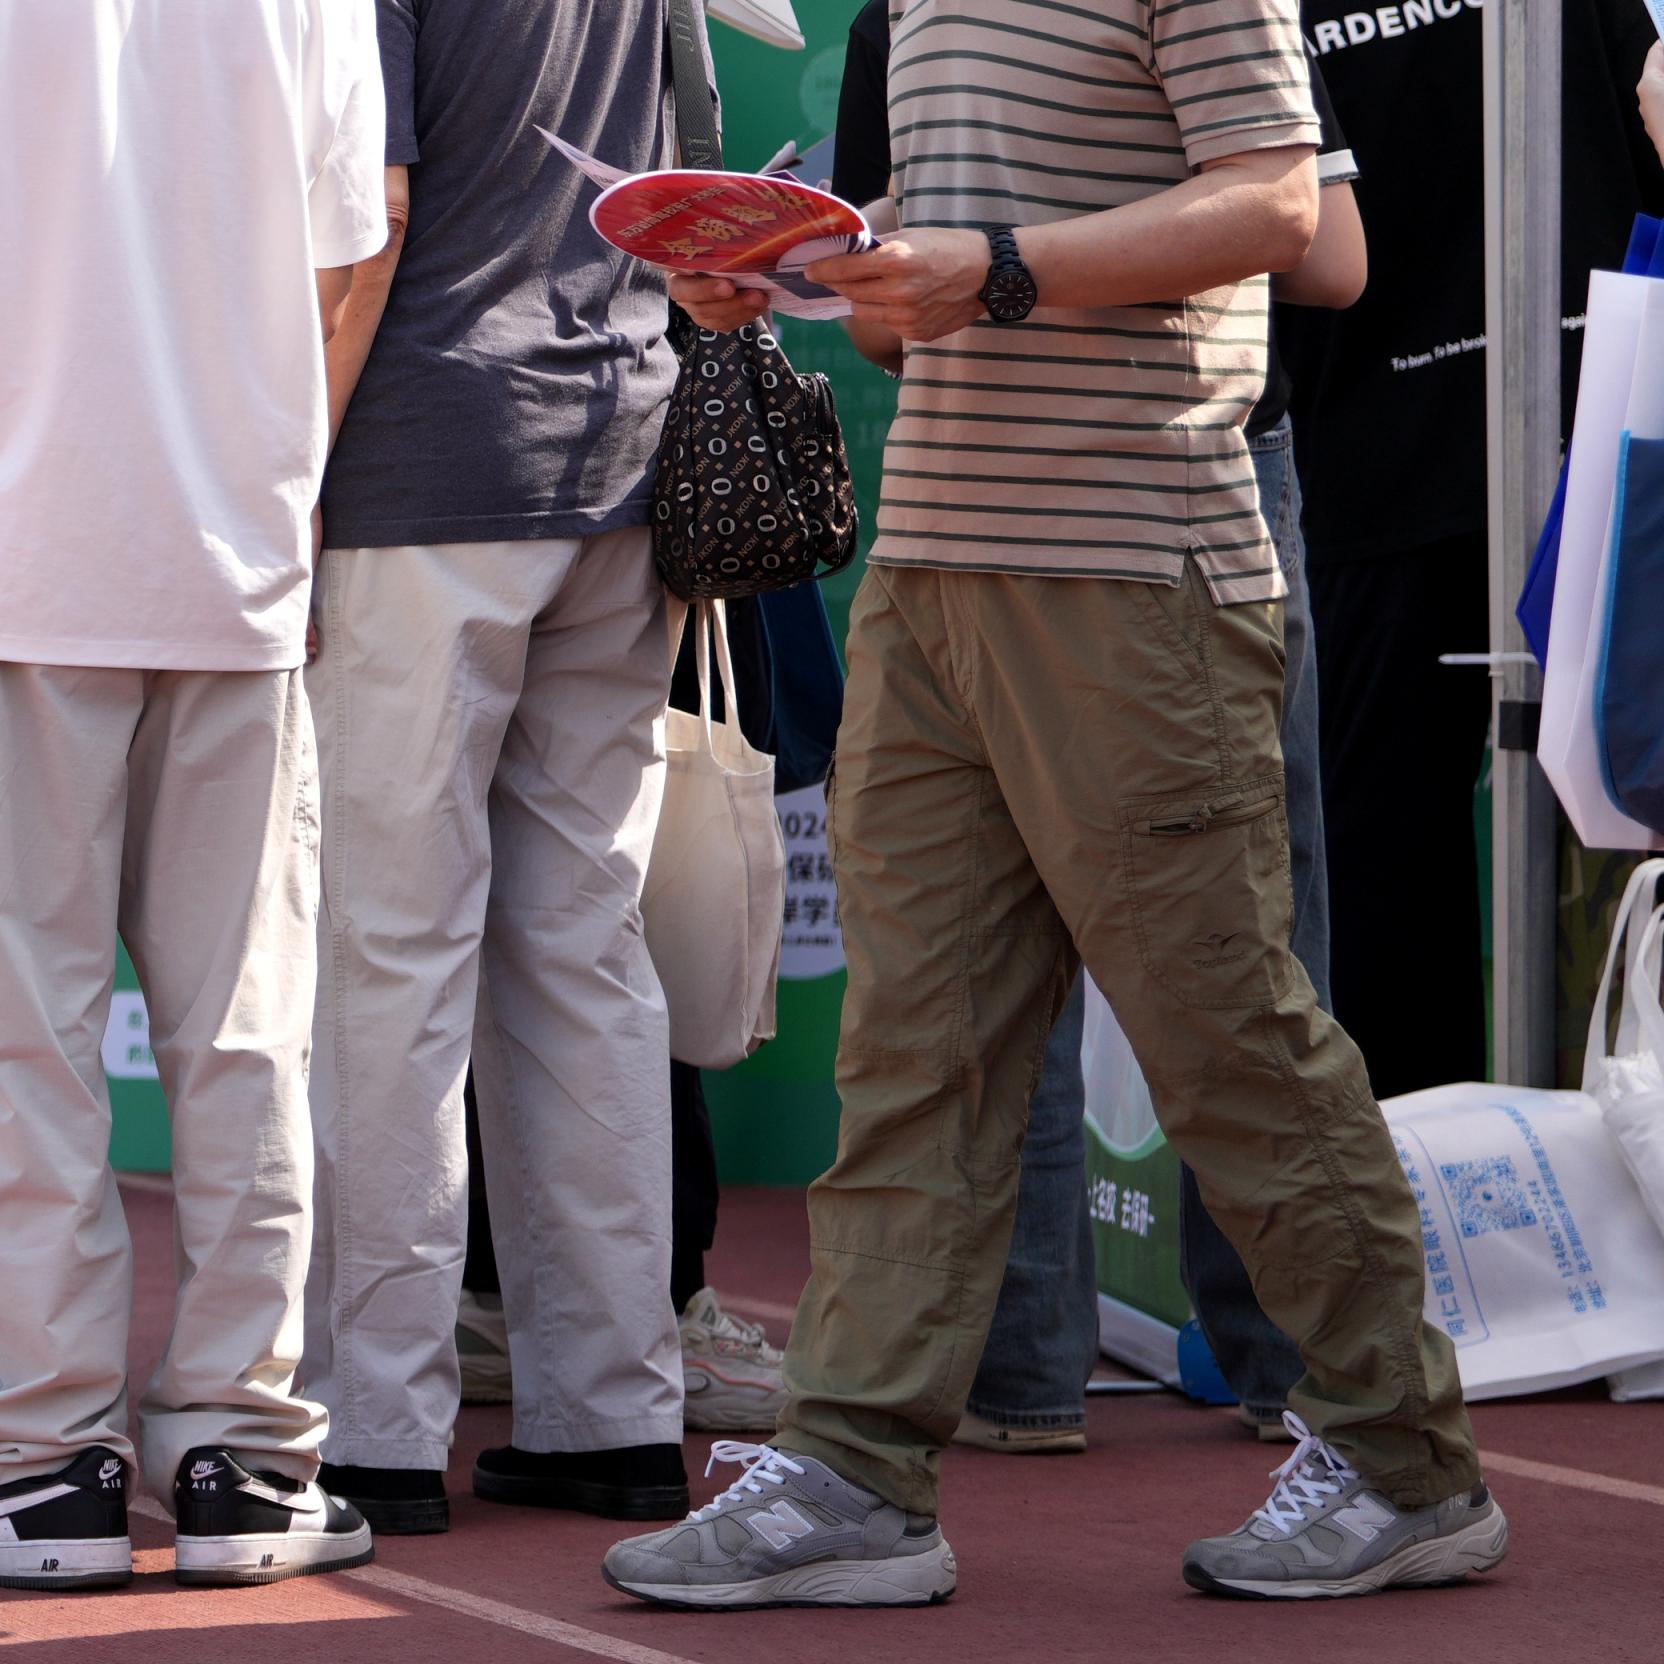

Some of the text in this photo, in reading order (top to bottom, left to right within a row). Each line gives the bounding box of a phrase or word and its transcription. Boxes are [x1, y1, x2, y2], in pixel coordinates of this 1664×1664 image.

[104, 1459, 121, 1472] NIKE
[194, 1460, 215, 1473] NIKE
[102, 1479, 122, 1489] AIR
[191, 1480, 216, 1491] AIR
[41, 1559, 58, 1572] AIR
[258, 1553, 274, 1568] AIR
